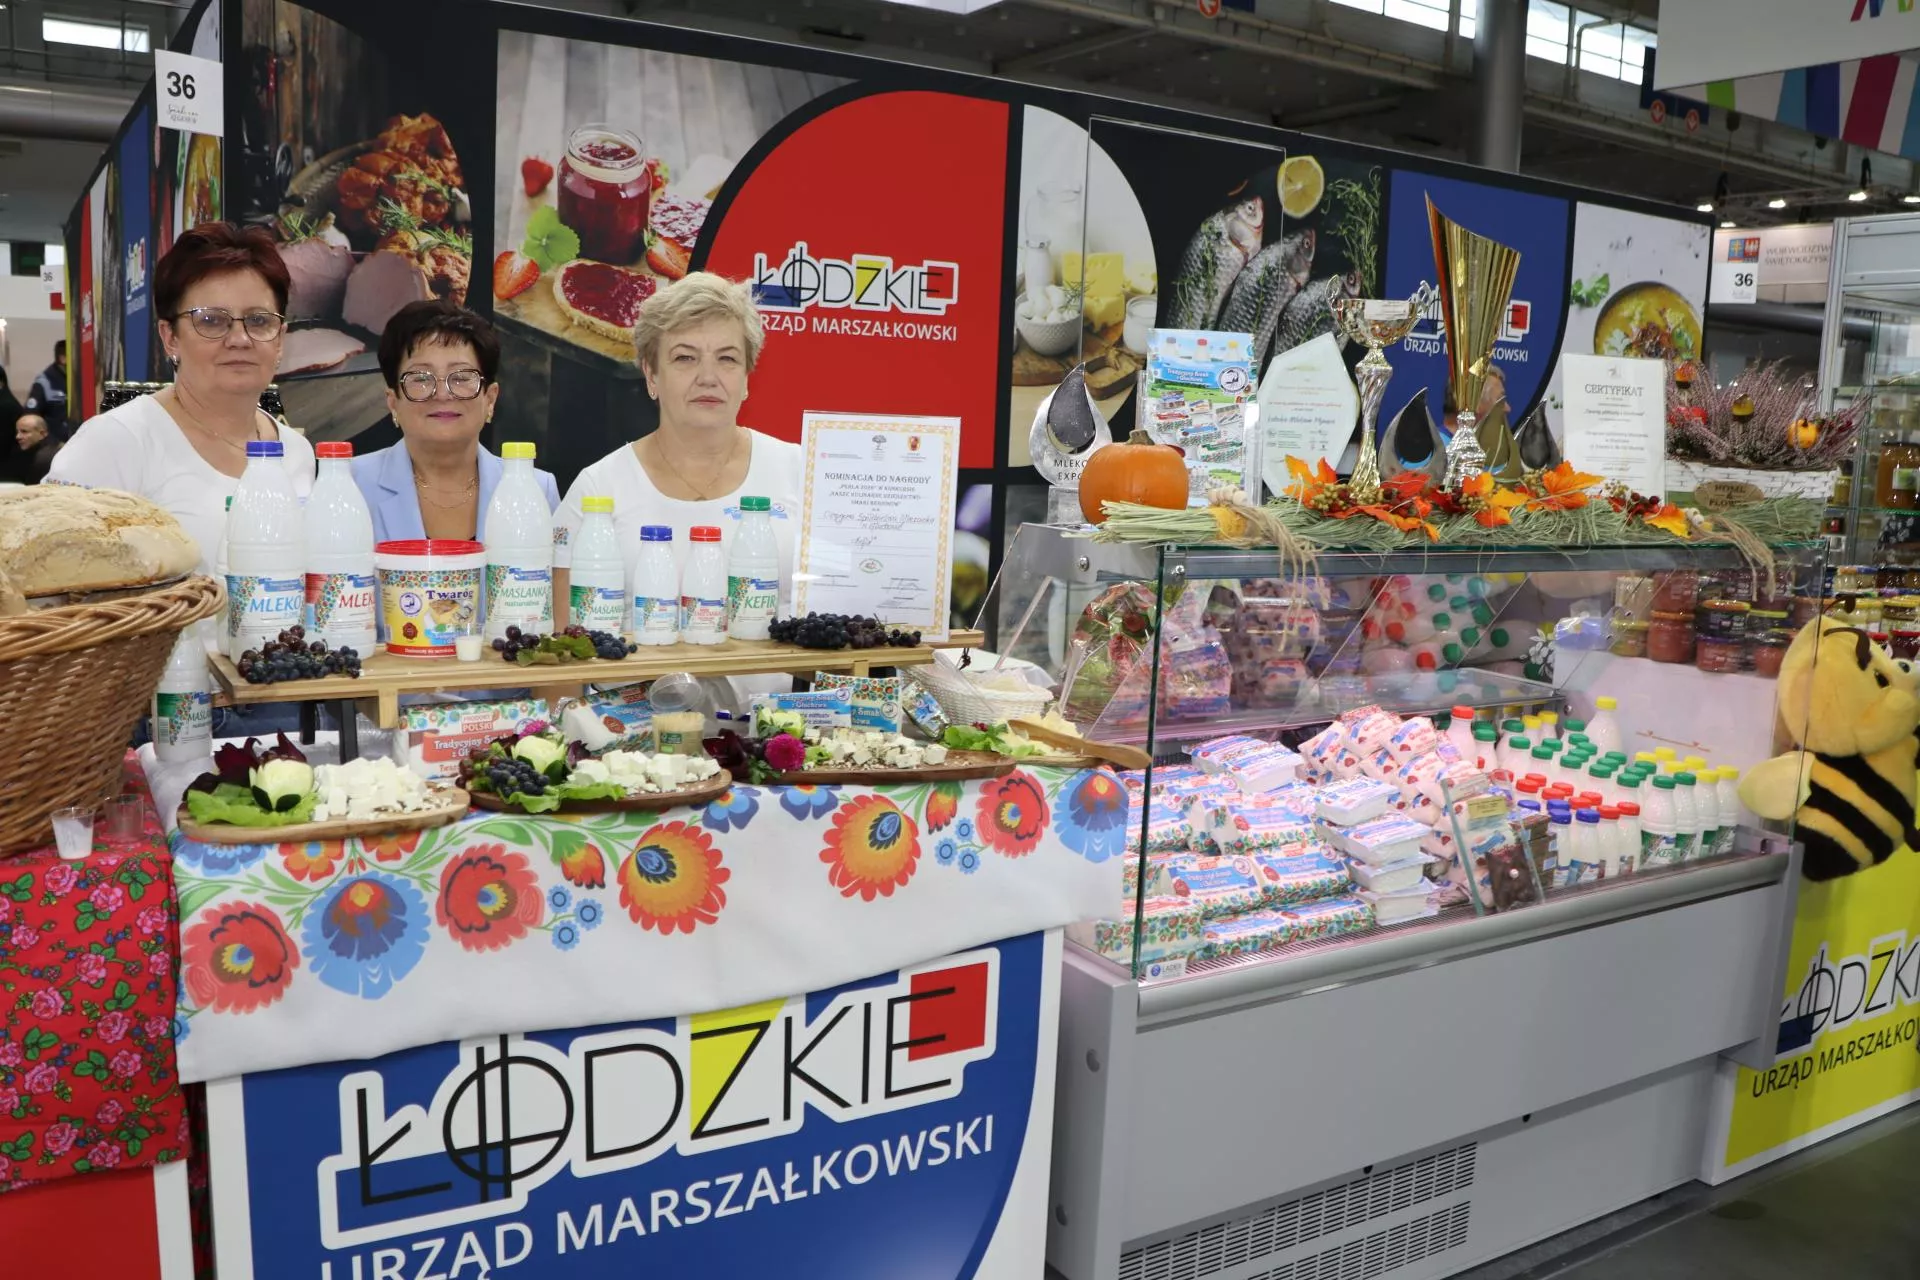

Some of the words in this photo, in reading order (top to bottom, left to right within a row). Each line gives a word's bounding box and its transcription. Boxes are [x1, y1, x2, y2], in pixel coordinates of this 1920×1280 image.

[167, 71, 196, 99] 36
[43, 271, 53, 282] 36
[757, 245, 944, 311] ŁÓDZKIE
[1734, 273, 1753, 287] 36
[759, 314, 807, 336] RZĄD
[812, 316, 957, 341] MARSZAŁKOWSKI
[1403, 339, 1440, 356] URZĄD
[1584, 383, 1645, 397] CERTYFIKAT
[824, 472, 874, 482] NOMINACJA
[876, 474, 888, 483] DO
[889, 475, 932, 485] NAGRODY
[249, 595, 301, 613] MLEKO
[744, 595, 777, 610] KEFIR
[462, 722, 493, 732] POLSKI
[434, 738, 482, 751] Tradycyjny
[1752, 1056, 1815, 1098] URZĄD
[356, 985, 956, 1208] ŁÓDZKIE
[556, 1114, 993, 1254] MARSZAŁKOWSKI
